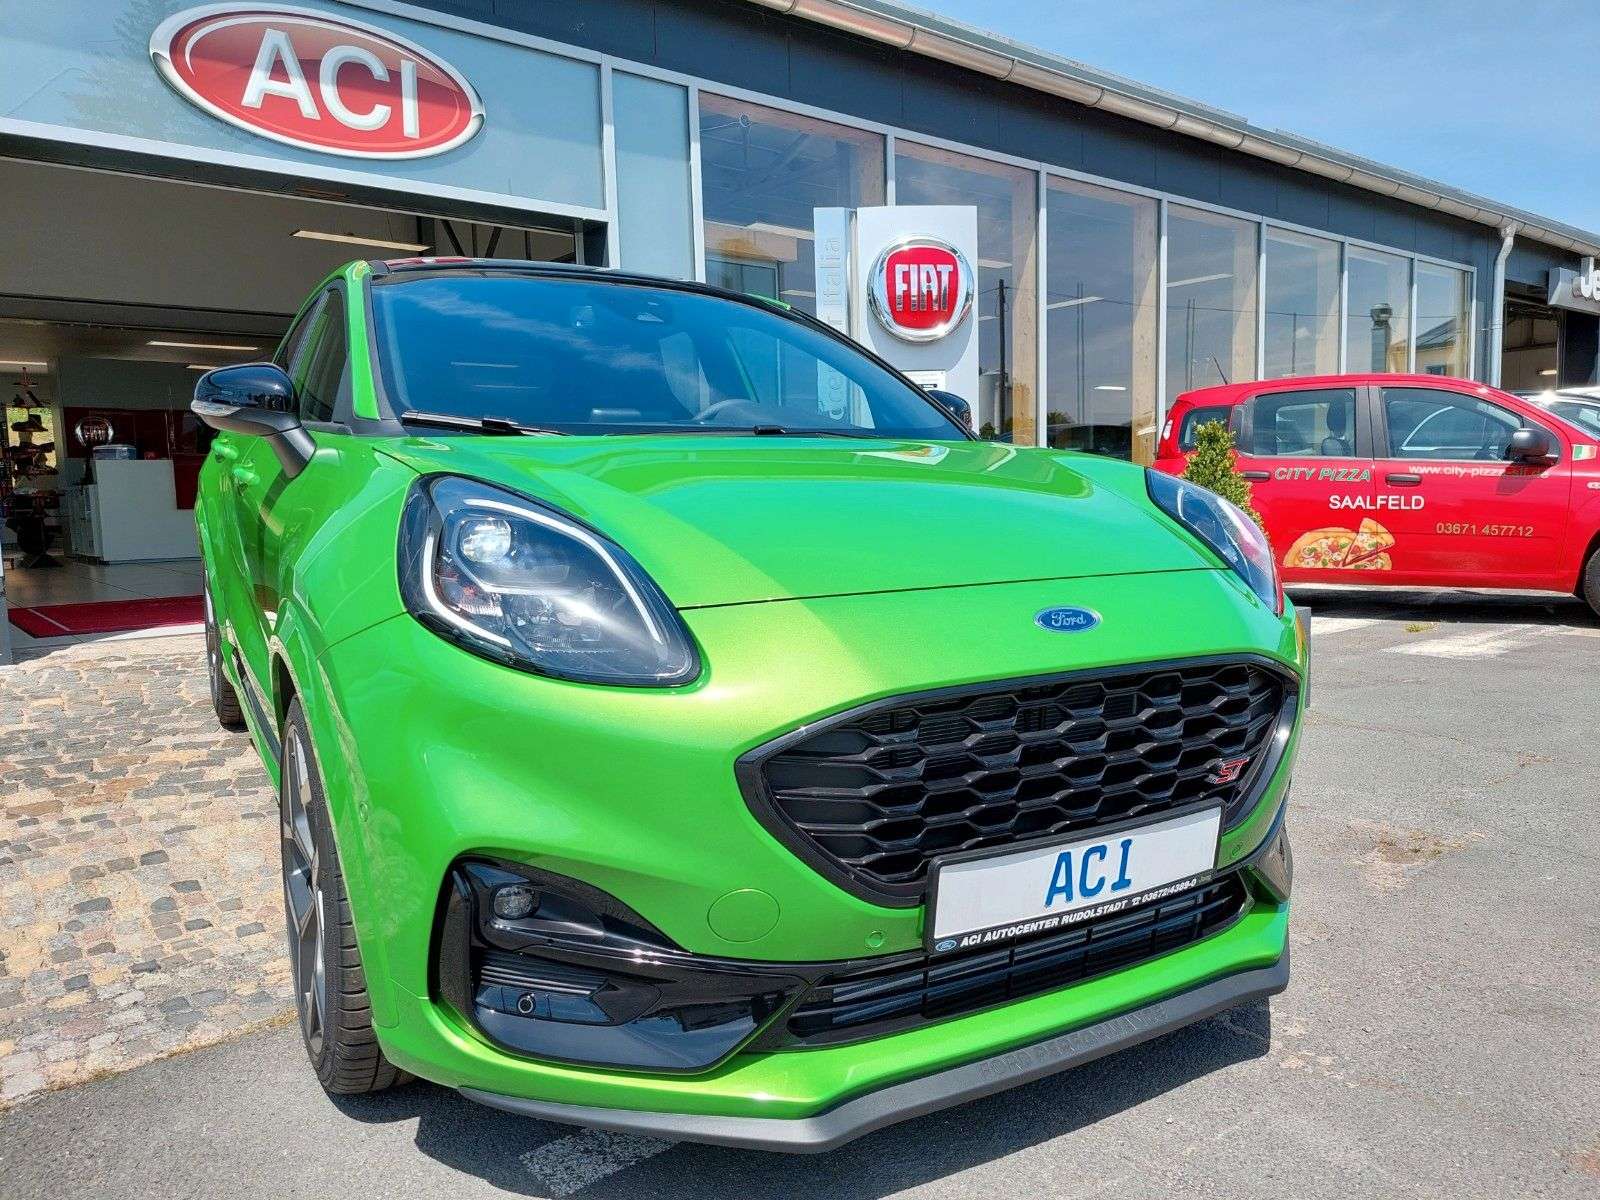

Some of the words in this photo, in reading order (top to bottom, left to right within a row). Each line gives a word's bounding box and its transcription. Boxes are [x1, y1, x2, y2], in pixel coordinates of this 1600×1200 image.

[240, 28, 420, 139] ACI
[894, 263, 954, 312] FIAT
[1274, 466, 1314, 481] CITY
[1318, 467, 1371, 483] PIZZA
[1328, 494, 1425, 511] SAALFELD
[1435, 521, 1477, 536] 03671
[1481, 523, 1535, 538] 457712
[1050, 610, 1087, 627] Ford
[1044, 837, 1134, 909] ACI
[960, 933, 982, 948] ACI
[984, 917, 1060, 943] AUTOCENTER
[1061, 899, 1129, 926] RUDOLSTADT
